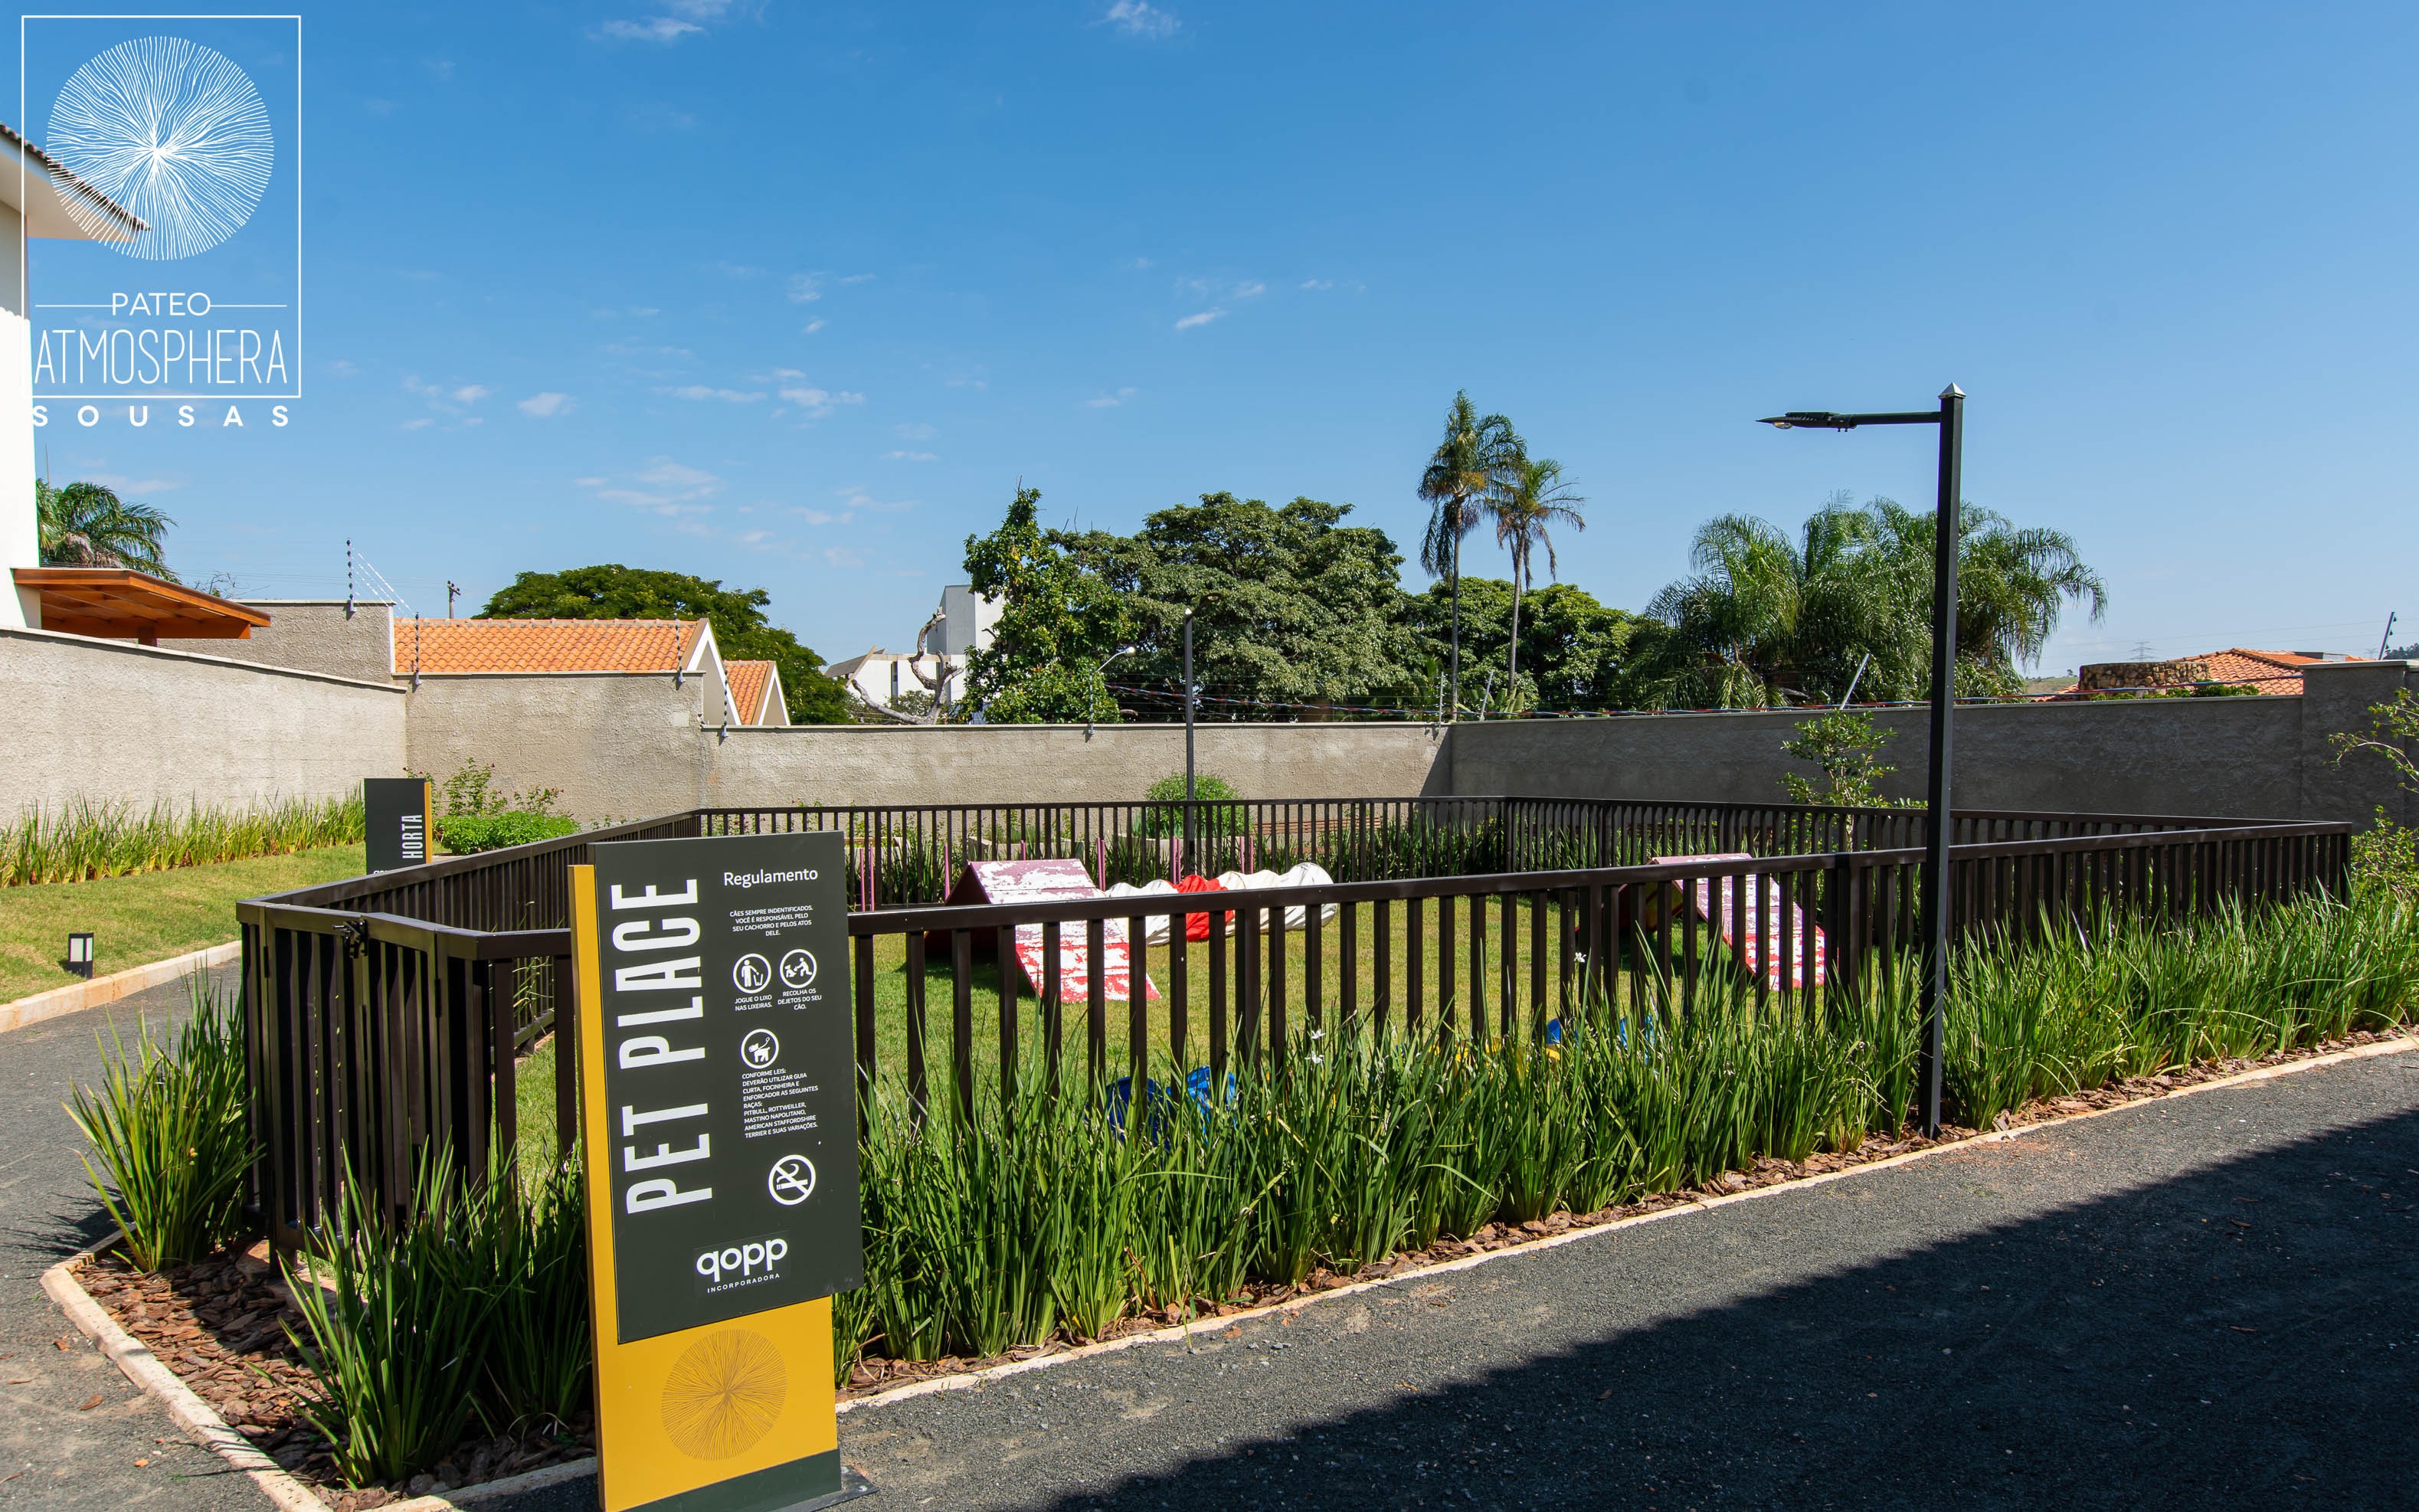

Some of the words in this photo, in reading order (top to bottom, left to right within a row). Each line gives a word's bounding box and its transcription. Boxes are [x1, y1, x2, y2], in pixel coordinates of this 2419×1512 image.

[401, 814, 424, 859] HORTA
[723, 869, 818, 888] Regulamento
[768, 905, 813, 914] INDENTIFICADOS.
[755, 914, 794, 922] RESPONSÁVEL
[610, 879, 705, 1069] PLACE
[748, 1002, 773, 1010] LIXEIRAS.
[777, 997, 801, 1005] DEJETOS
[741, 1070, 773, 1079] CONFORME
[742, 1078, 768, 1086] DEVERÃO
[769, 1075, 793, 1083] UTILIZAR
[763, 1082, 795, 1091] FOCINHEIRA
[743, 1091, 780, 1101] ENFORCADOR
[789, 1085, 819, 1095] SEGUINTES
[744, 1115, 769, 1124] MASTINO
[744, 1121, 773, 1131] AMERICAN
[774, 1114, 817, 1127] STAFFORDSHIRE
[745, 1130, 768, 1138] TERRIER
[622, 1103, 713, 1214] PET
[696, 1238, 788, 1282] qopp
[707, 1273, 780, 1294] INCORPORADORA
